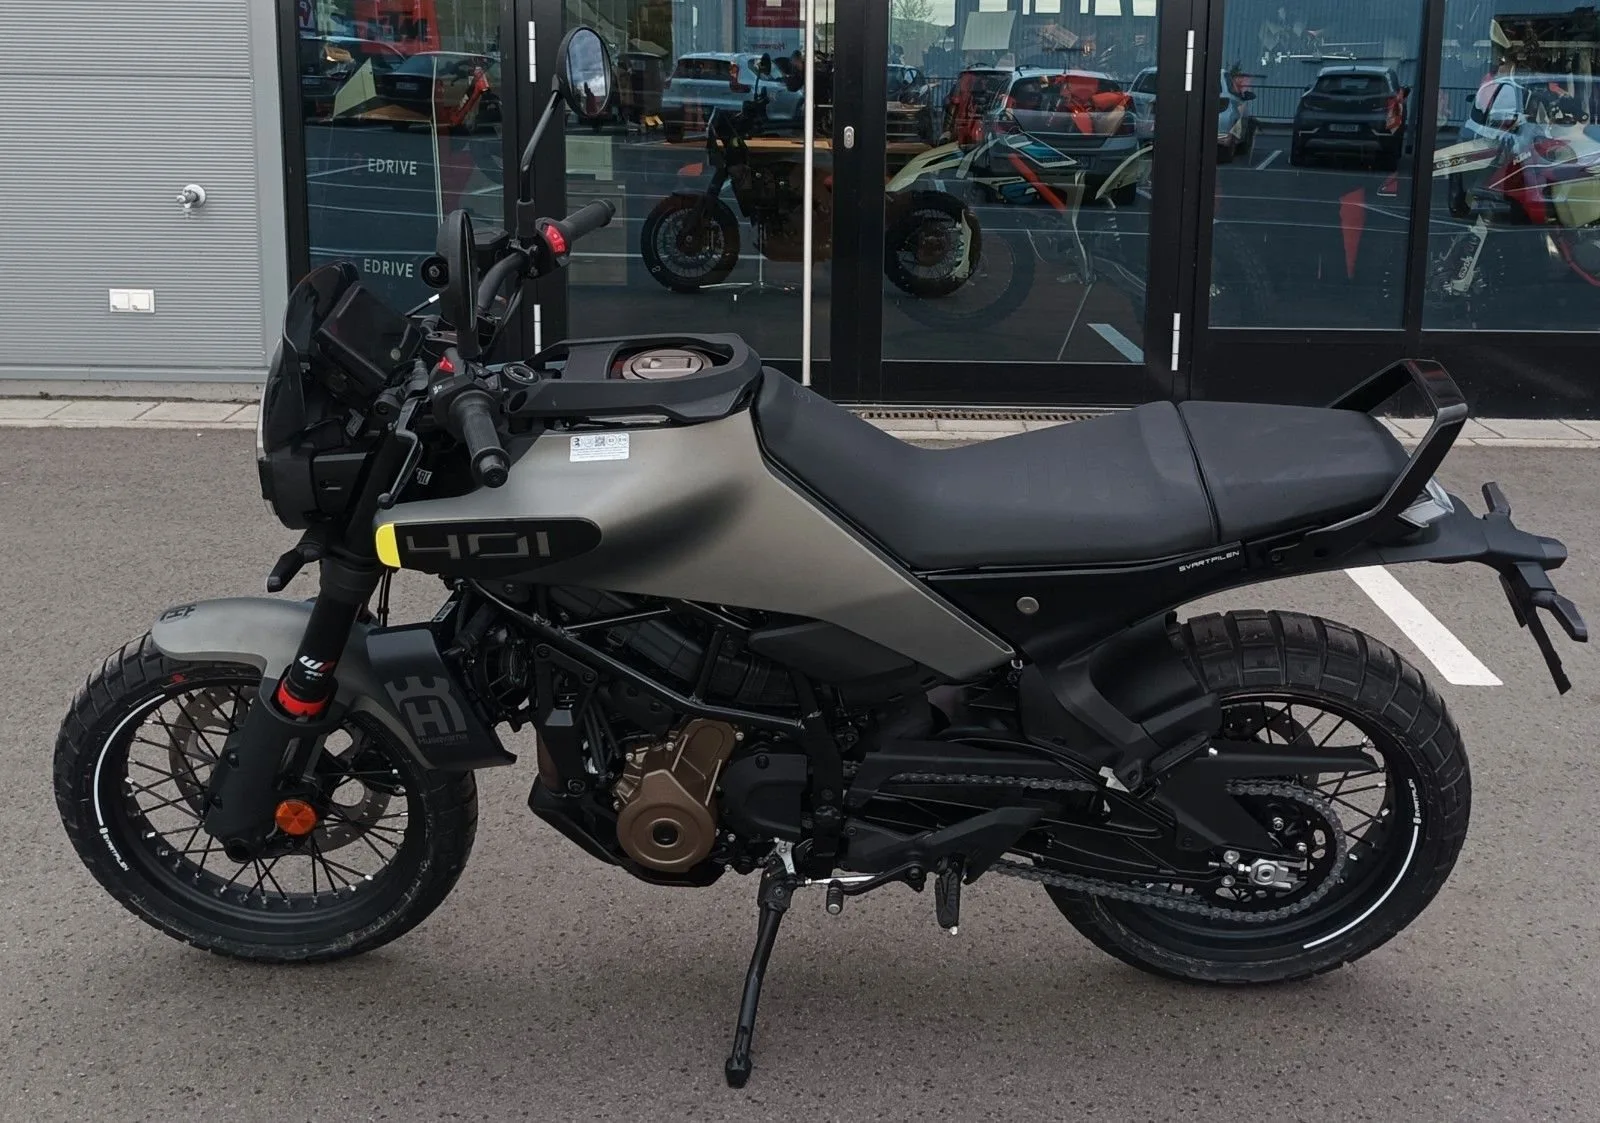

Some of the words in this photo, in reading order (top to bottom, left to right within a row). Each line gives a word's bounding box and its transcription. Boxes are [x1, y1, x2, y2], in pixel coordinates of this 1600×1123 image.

[367, 158, 417, 176] EDRIVE
[363, 258, 414, 278] EDRIVE
[405, 531, 550, 559] 401
[1179, 550, 1240, 571] SVARTPILEN
